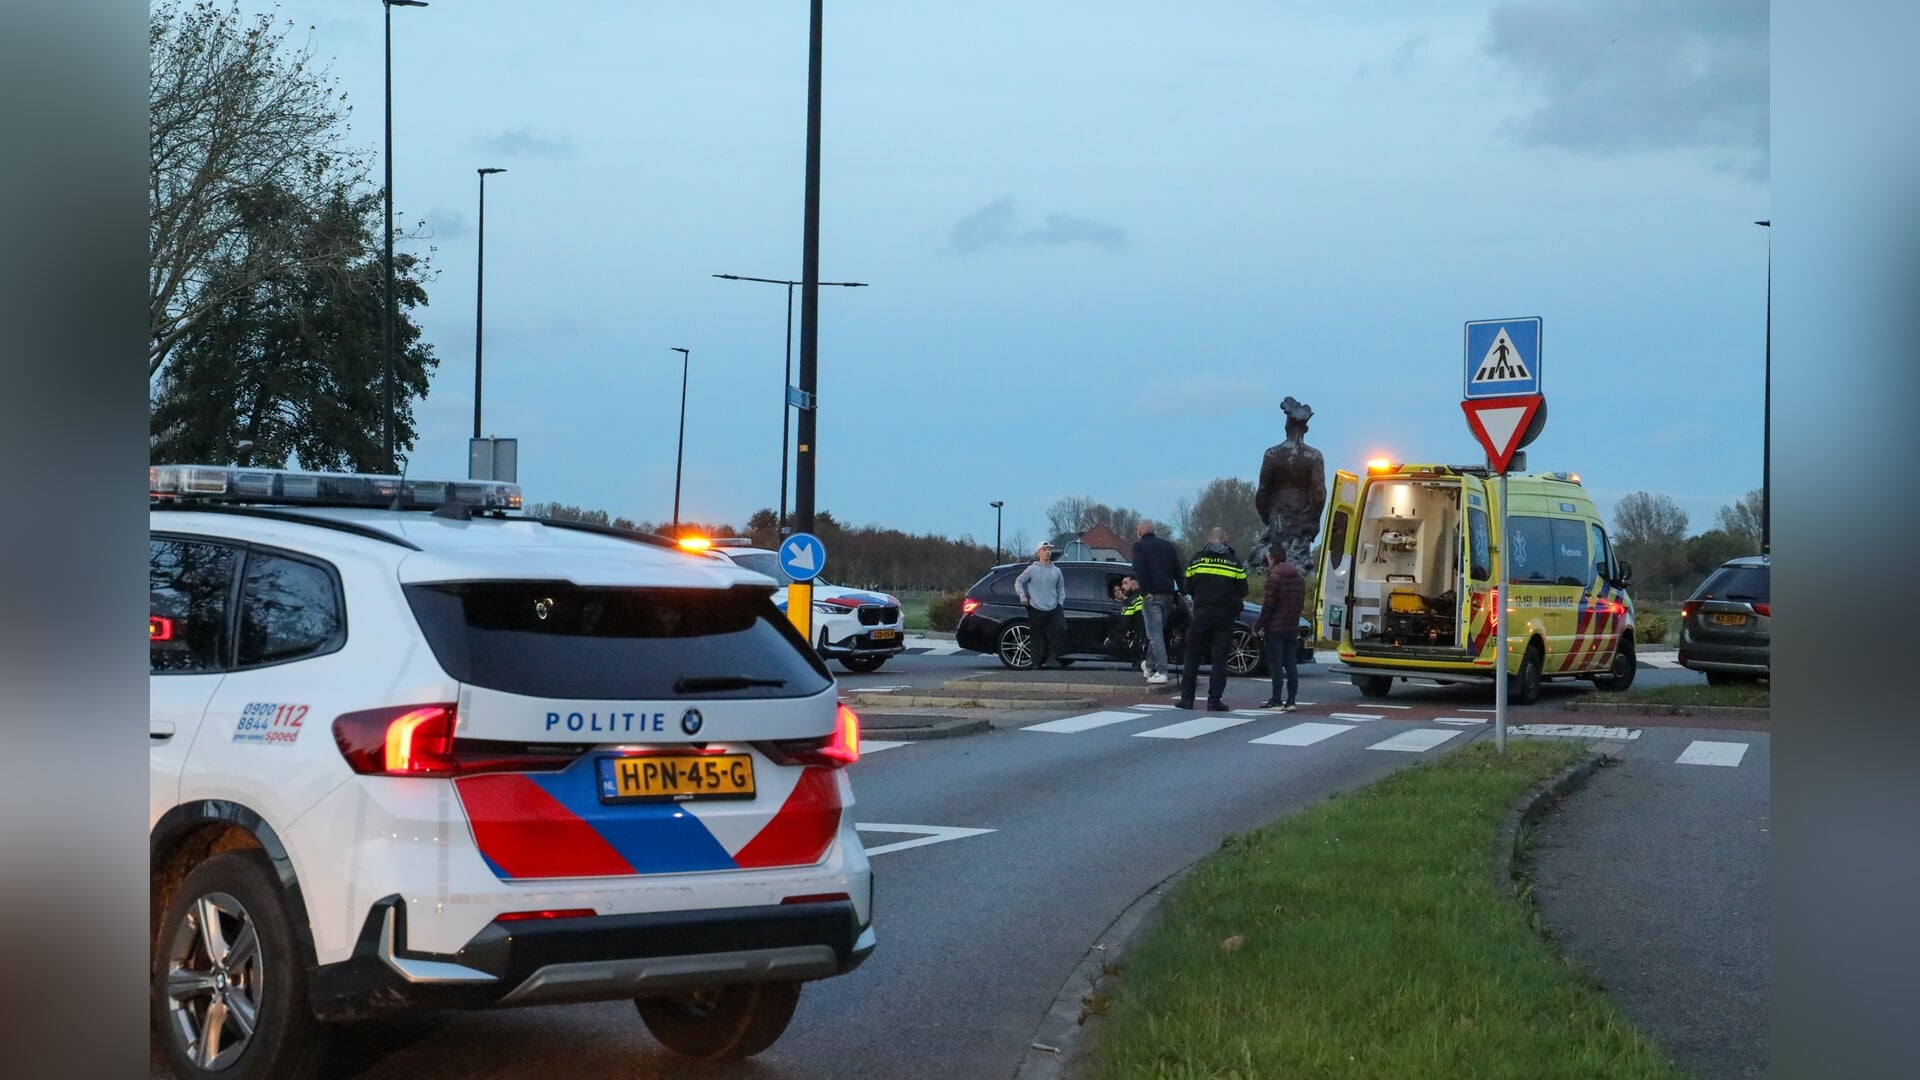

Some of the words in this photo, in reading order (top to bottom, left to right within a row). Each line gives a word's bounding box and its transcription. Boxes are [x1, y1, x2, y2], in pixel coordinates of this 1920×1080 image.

[1539, 595, 1574, 608] AMBULANCE
[243, 703, 277, 716] 0900
[274, 704, 309, 727] 112
[237, 717, 269, 731] 8844
[546, 713, 664, 731] POLITIE
[265, 730, 299, 744] spoed
[621, 761, 746, 791] HPN-45-G
[603, 779, 615, 790] NL
